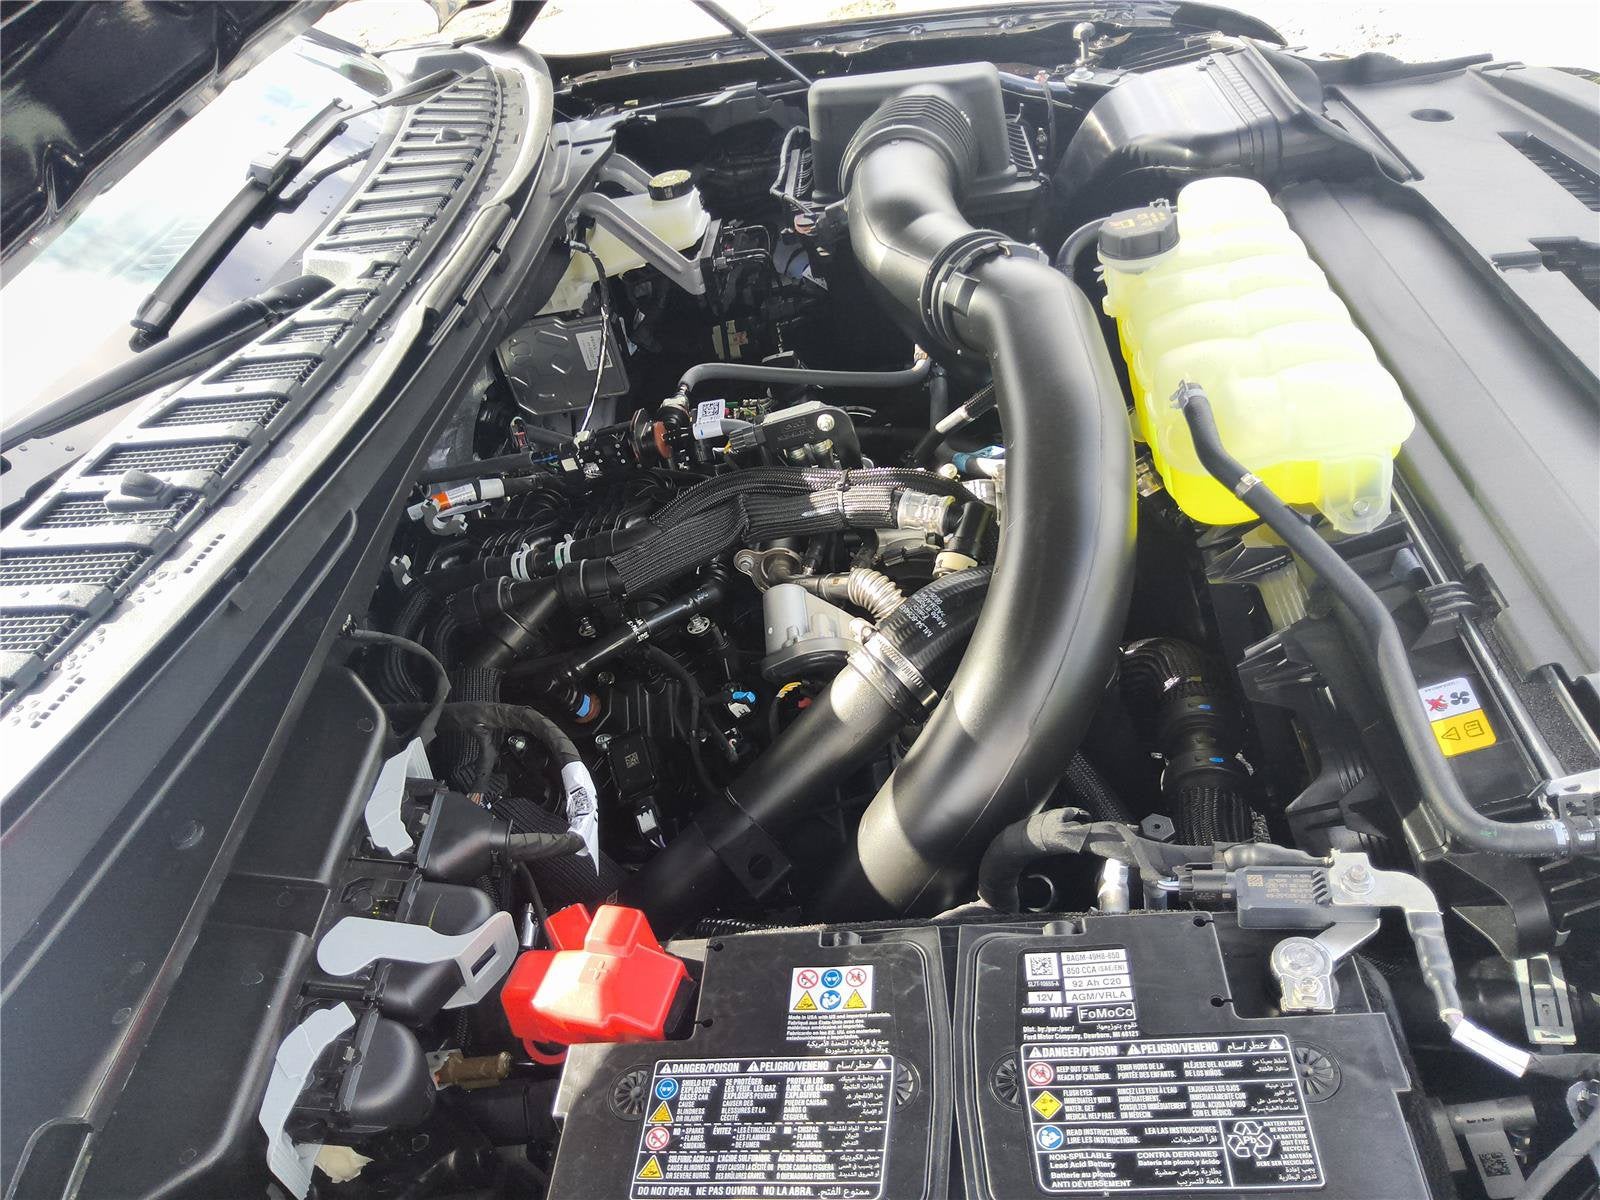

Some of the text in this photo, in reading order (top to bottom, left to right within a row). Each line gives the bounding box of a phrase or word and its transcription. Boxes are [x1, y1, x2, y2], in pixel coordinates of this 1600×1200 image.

[1072, 991, 1126, 1001] AGM/VRLA
[1050, 1006, 1073, 1018] MF
[1080, 1007, 1133, 1019] FoMoCo
[1042, 1046, 1118, 1057] DANGER/POISON
[1140, 1042, 1218, 1054] PELIGRO/VENENO
[672, 1062, 740, 1073] DANGER/POISON
[760, 1061, 829, 1072] PELIGRO/VENENO
[1137, 1151, 1171, 1159] CONTRA
[1088, 1160, 1115, 1170] Battery
[1093, 1171, 1116, 1180] plomb
[1072, 1179, 1131, 1187] DÉVERSEMENT
[650, 1187, 666, 1195] NOT
[668, 1187, 692, 1195] OPEN.
[708, 1187, 725, 1195] PAS
[726, 1186, 758, 1195] OUVRIR.
[788, 1186, 814, 1195] ABRA.
